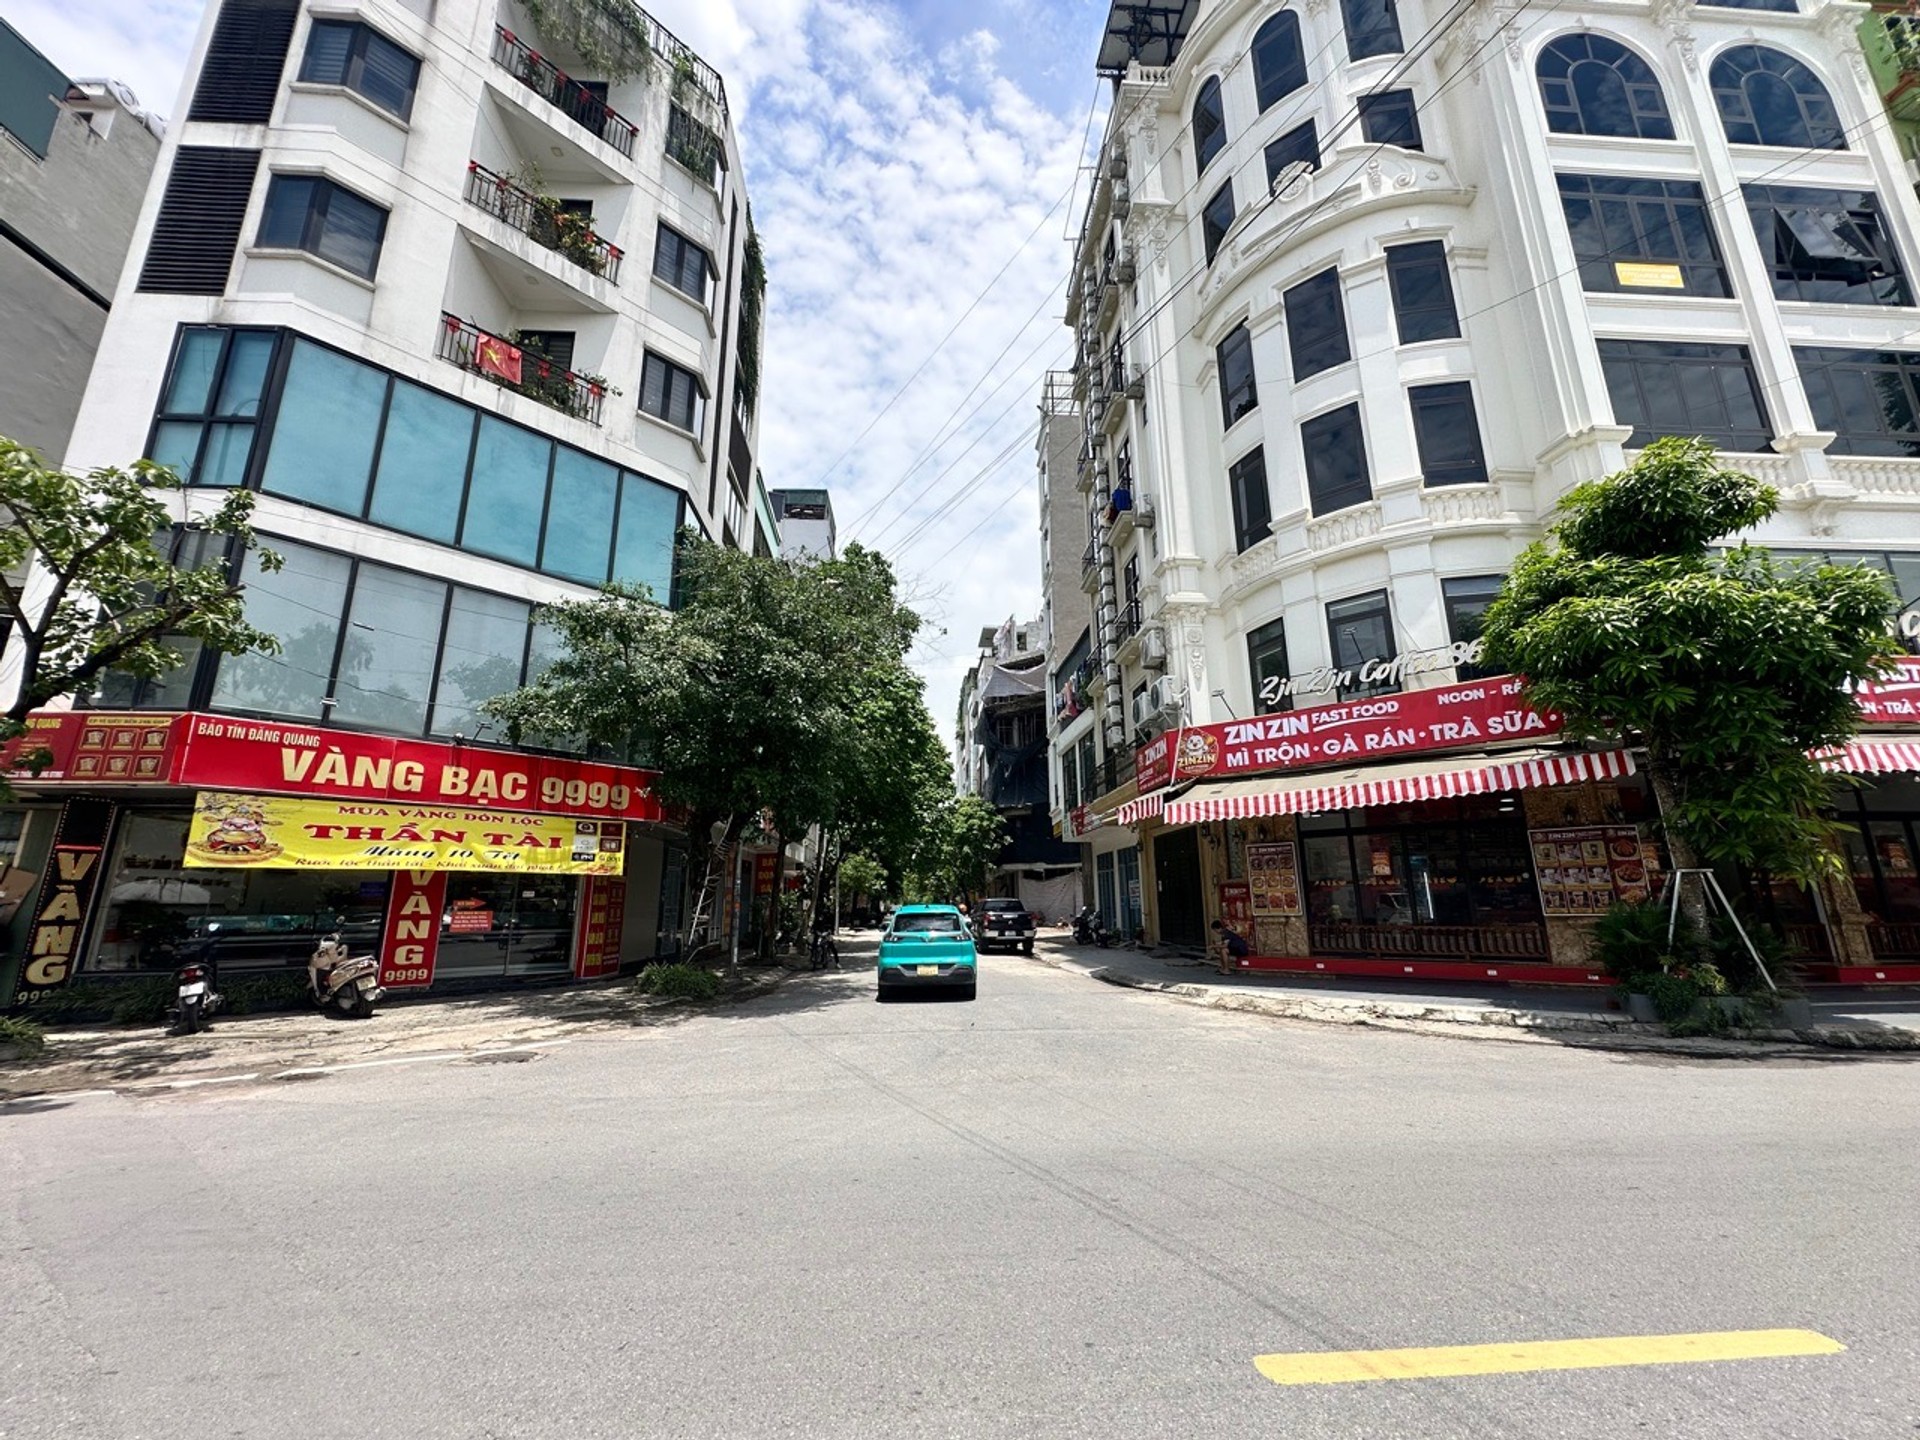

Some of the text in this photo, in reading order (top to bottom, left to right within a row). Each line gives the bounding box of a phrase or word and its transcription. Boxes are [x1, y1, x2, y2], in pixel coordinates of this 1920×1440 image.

[1437, 688, 1485, 706] NGON
[1311, 706, 1348, 724] FAST
[1352, 700, 1399, 717] FOOD
[283, 732, 320, 747] QUANG
[1226, 711, 1546, 768] MÌ TRỘN GÀ RÁN TRÀ SỮA
[281, 746, 630, 810] VÀNG BẠC 9999
[338, 806, 390, 816] MUA
[398, 808, 457, 819] VÀNG
[510, 816, 544, 827] LỘC
[303, 822, 562, 849] THẦN TÀI
[448, 850, 474, 858] 10
[26, 852, 97, 985] VÀNG
[394, 870, 434, 966] VÀNG
[384, 968, 428, 982] 9999
